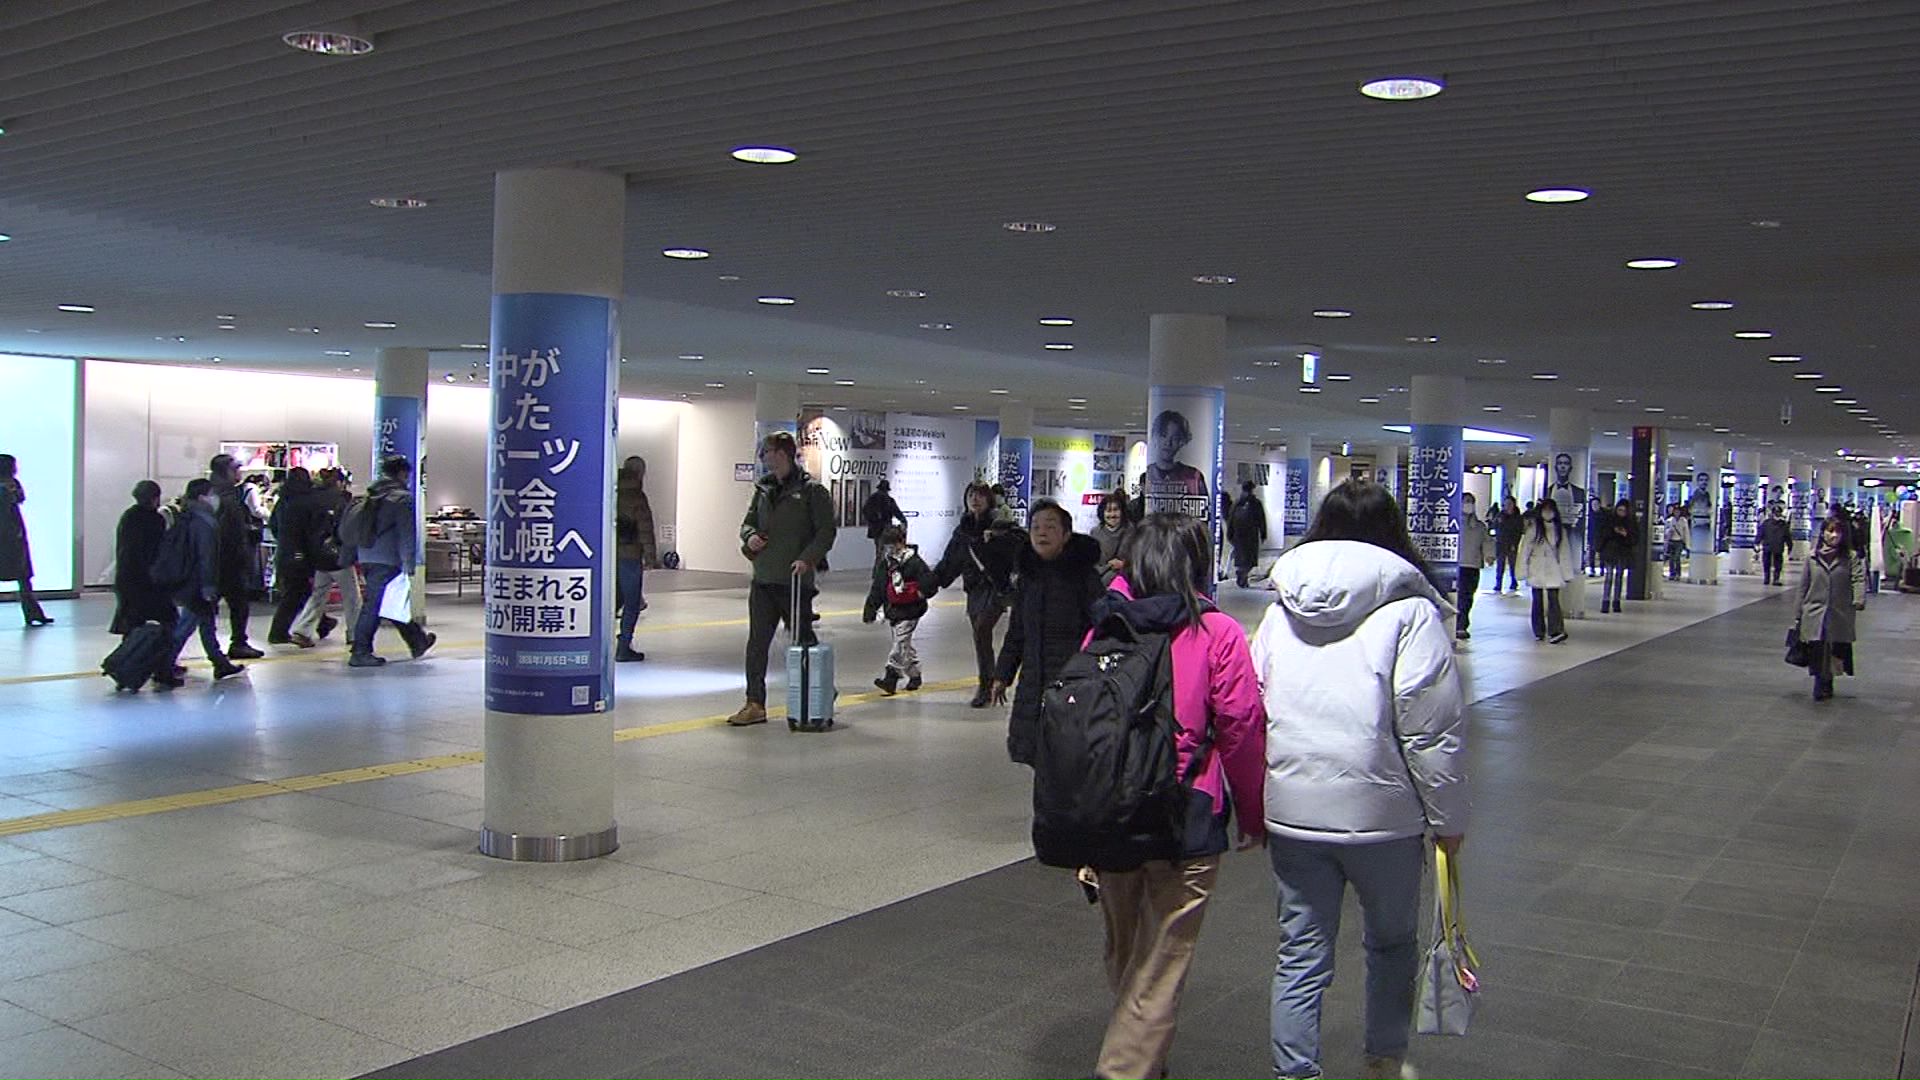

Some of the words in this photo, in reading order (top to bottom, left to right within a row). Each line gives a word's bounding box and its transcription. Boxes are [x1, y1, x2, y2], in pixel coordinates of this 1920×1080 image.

[495, 347, 561, 388] 中が
[495, 392, 550, 431] した
[820, 431, 850, 451] New
[830, 454, 889, 480] Opening
[492, 477, 558, 519] 大会
[490, 520, 594, 563] 札幌へ
